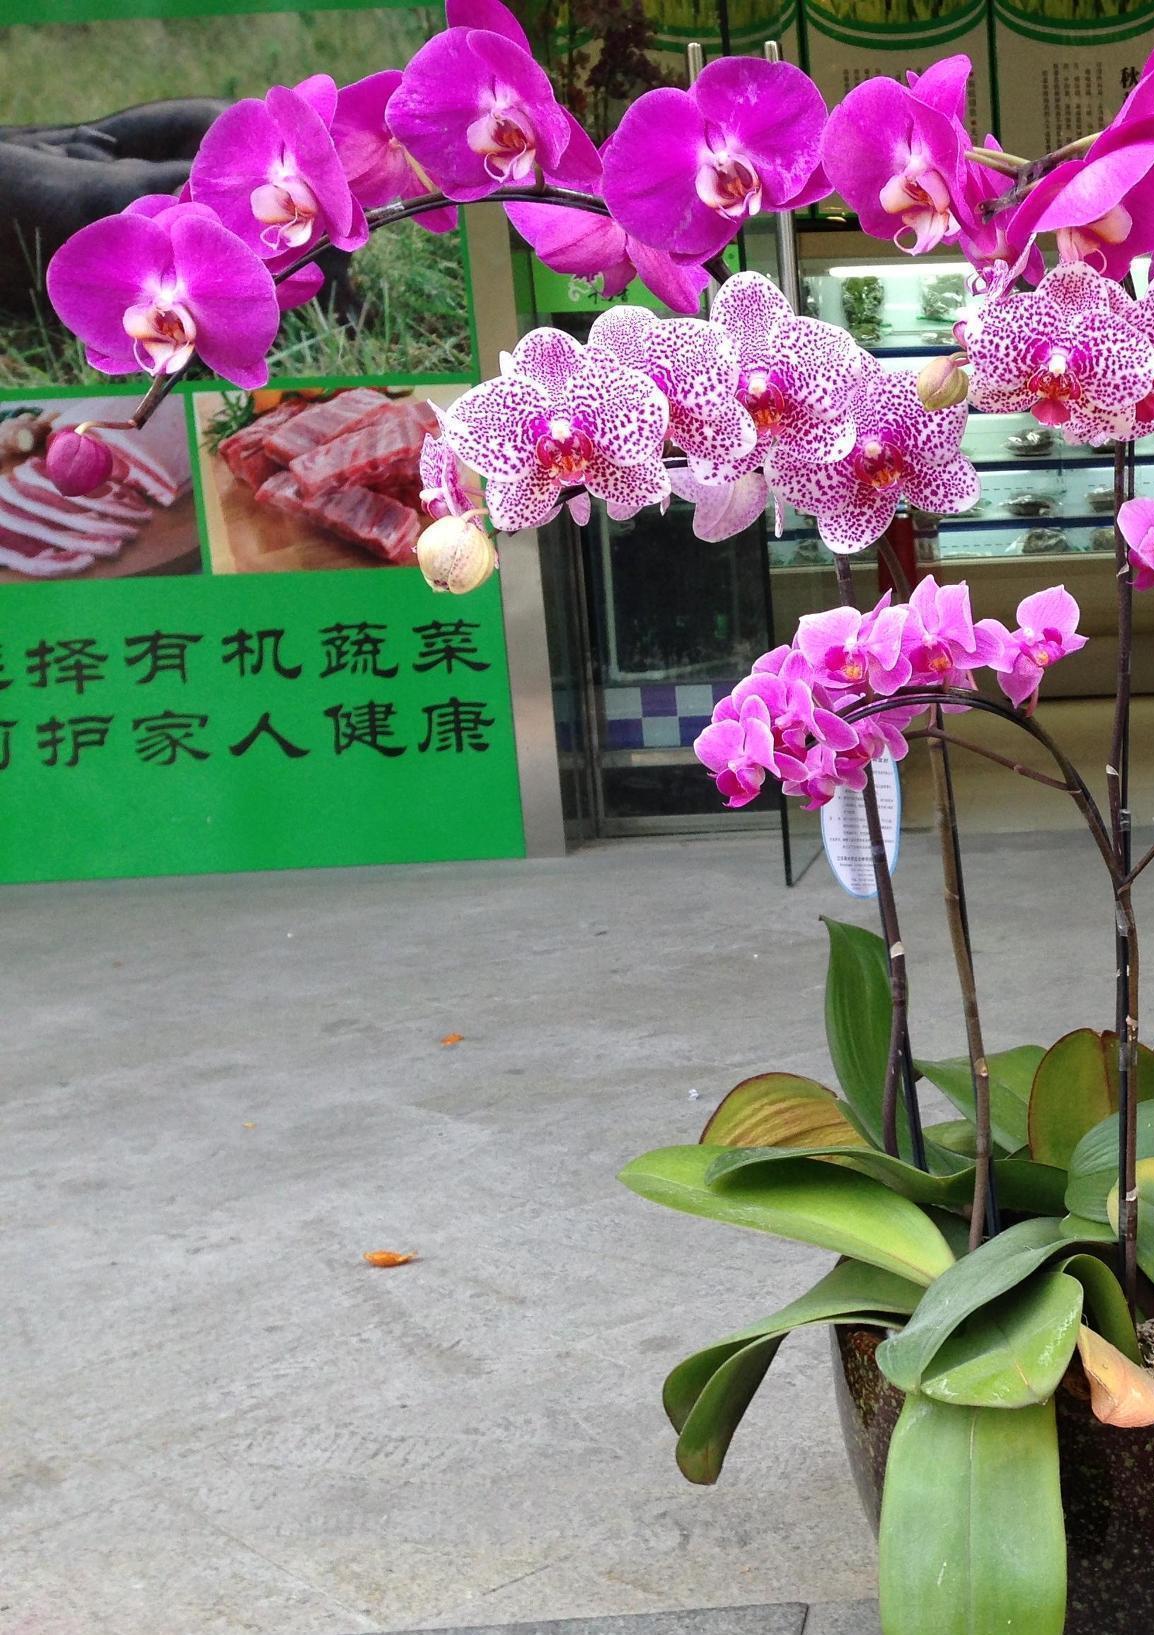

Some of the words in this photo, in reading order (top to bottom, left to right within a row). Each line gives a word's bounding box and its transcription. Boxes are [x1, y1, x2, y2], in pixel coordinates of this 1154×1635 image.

[0, 619, 491, 695] 择有机蔬菜
